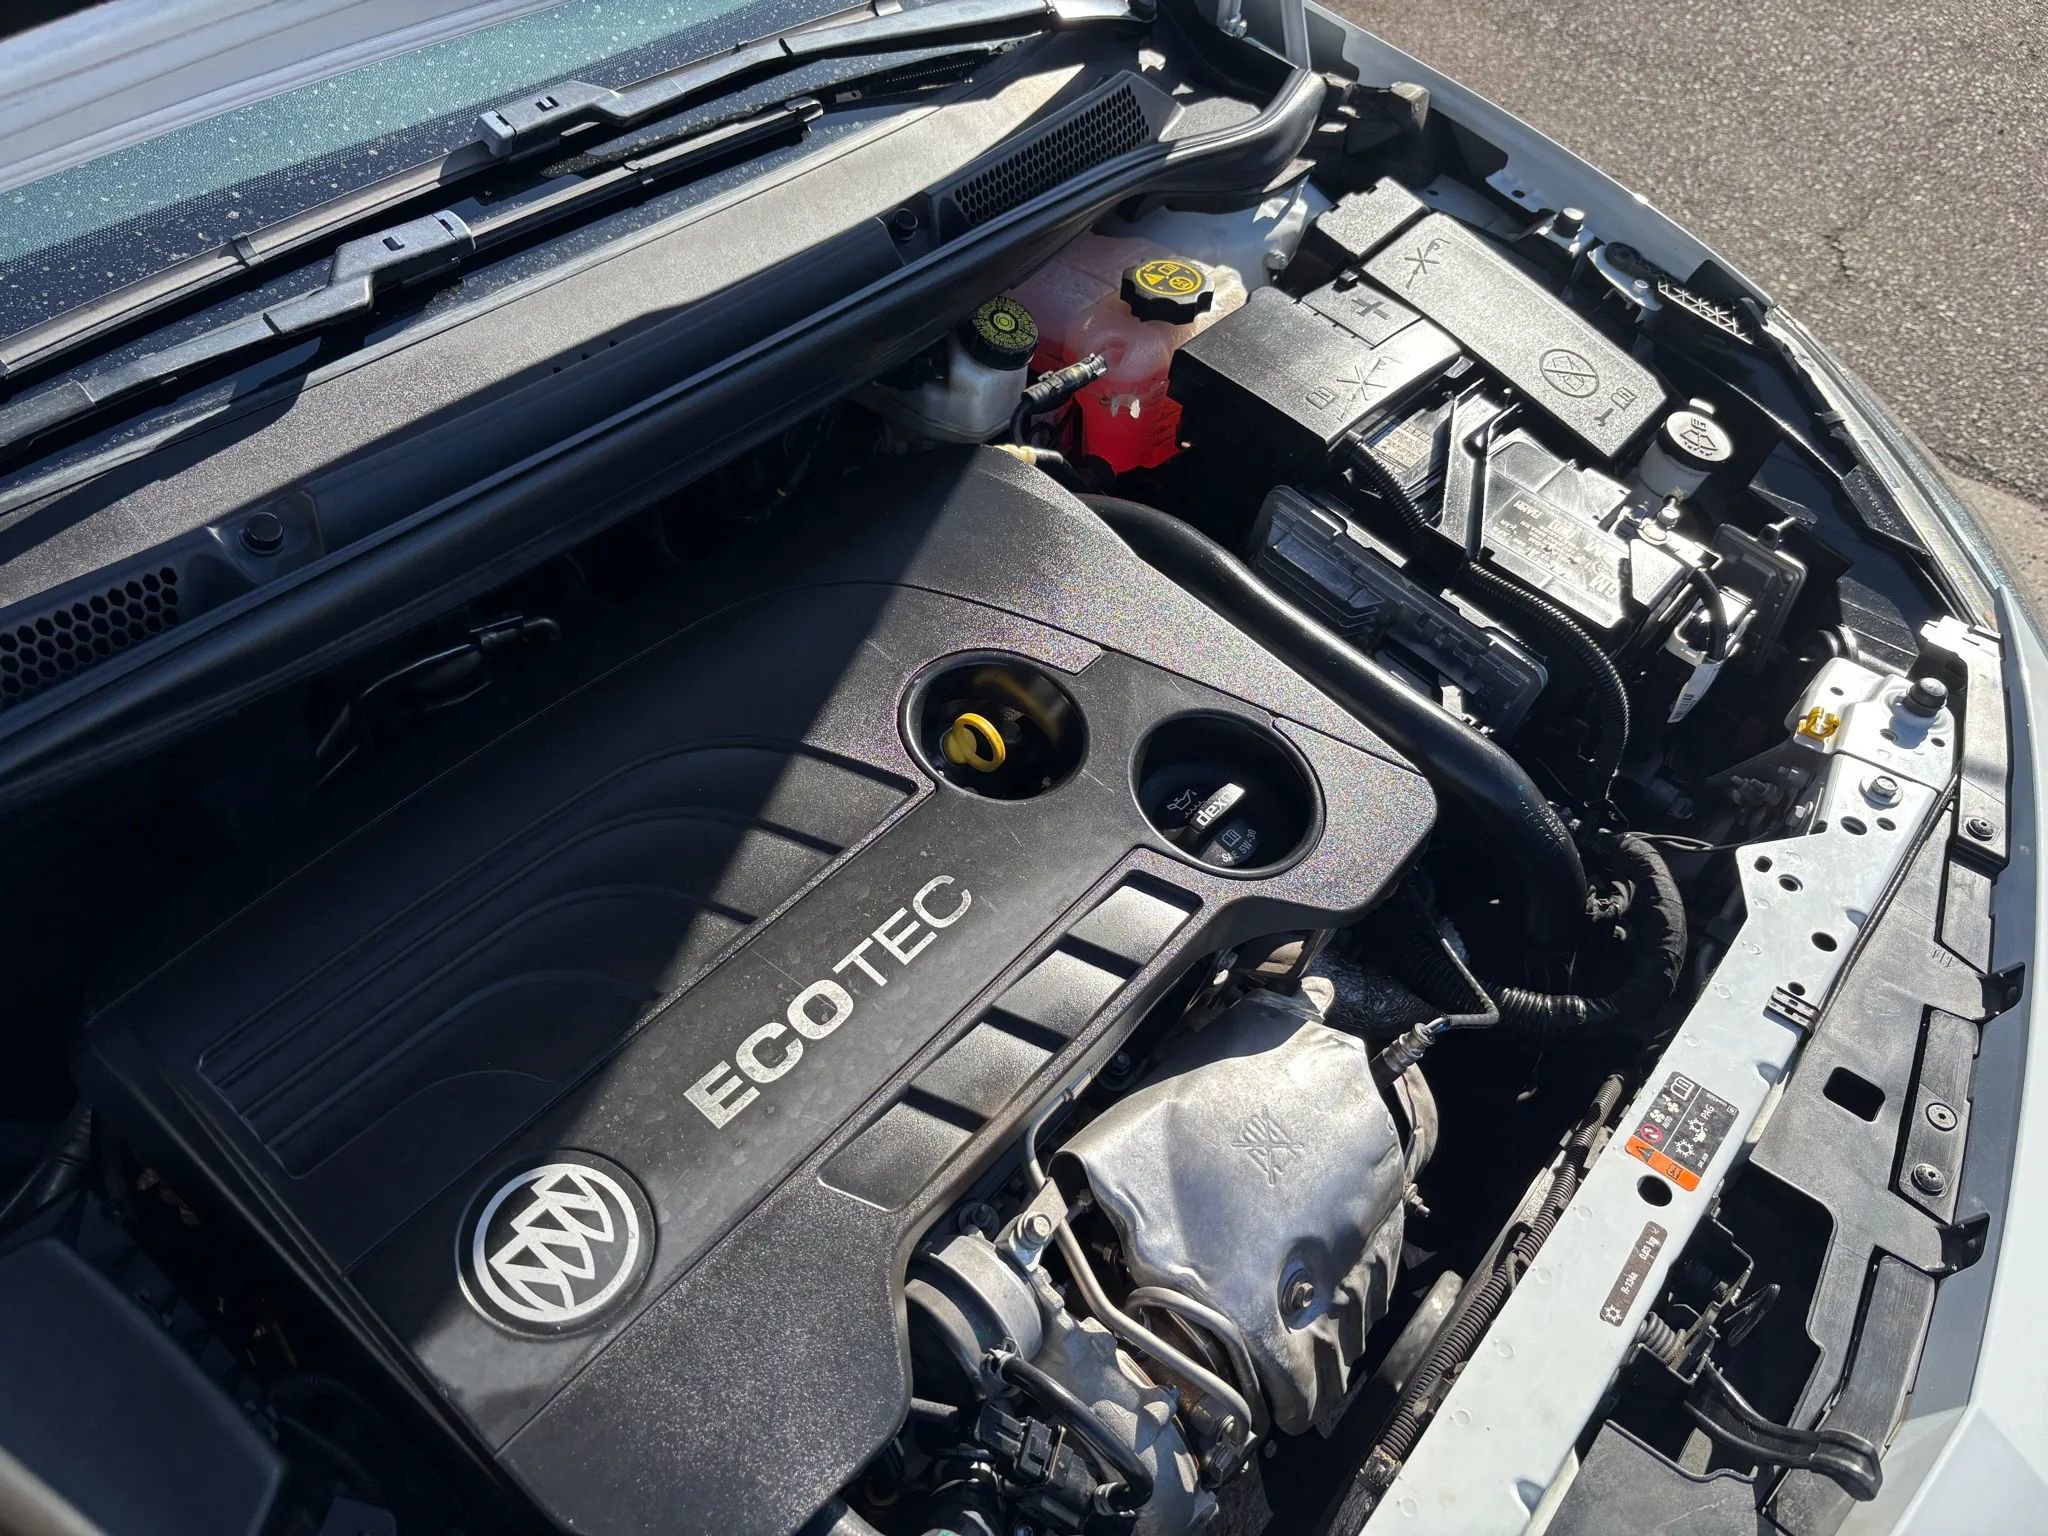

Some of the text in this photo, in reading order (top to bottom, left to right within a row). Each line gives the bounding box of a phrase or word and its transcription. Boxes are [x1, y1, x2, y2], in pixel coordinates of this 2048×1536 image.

[1513, 500, 1542, 519] FIAMM
[1588, 574, 1617, 598] GM
[1196, 788, 1240, 826] dexo
[1221, 829, 1257, 863] SAE 5W-30
[683, 875, 972, 1129] ECOTEC
[1662, 1115, 1673, 1129] AUTO
[1700, 1104, 1715, 1120] PAG
[1620, 1272, 1639, 1295] R-134a
